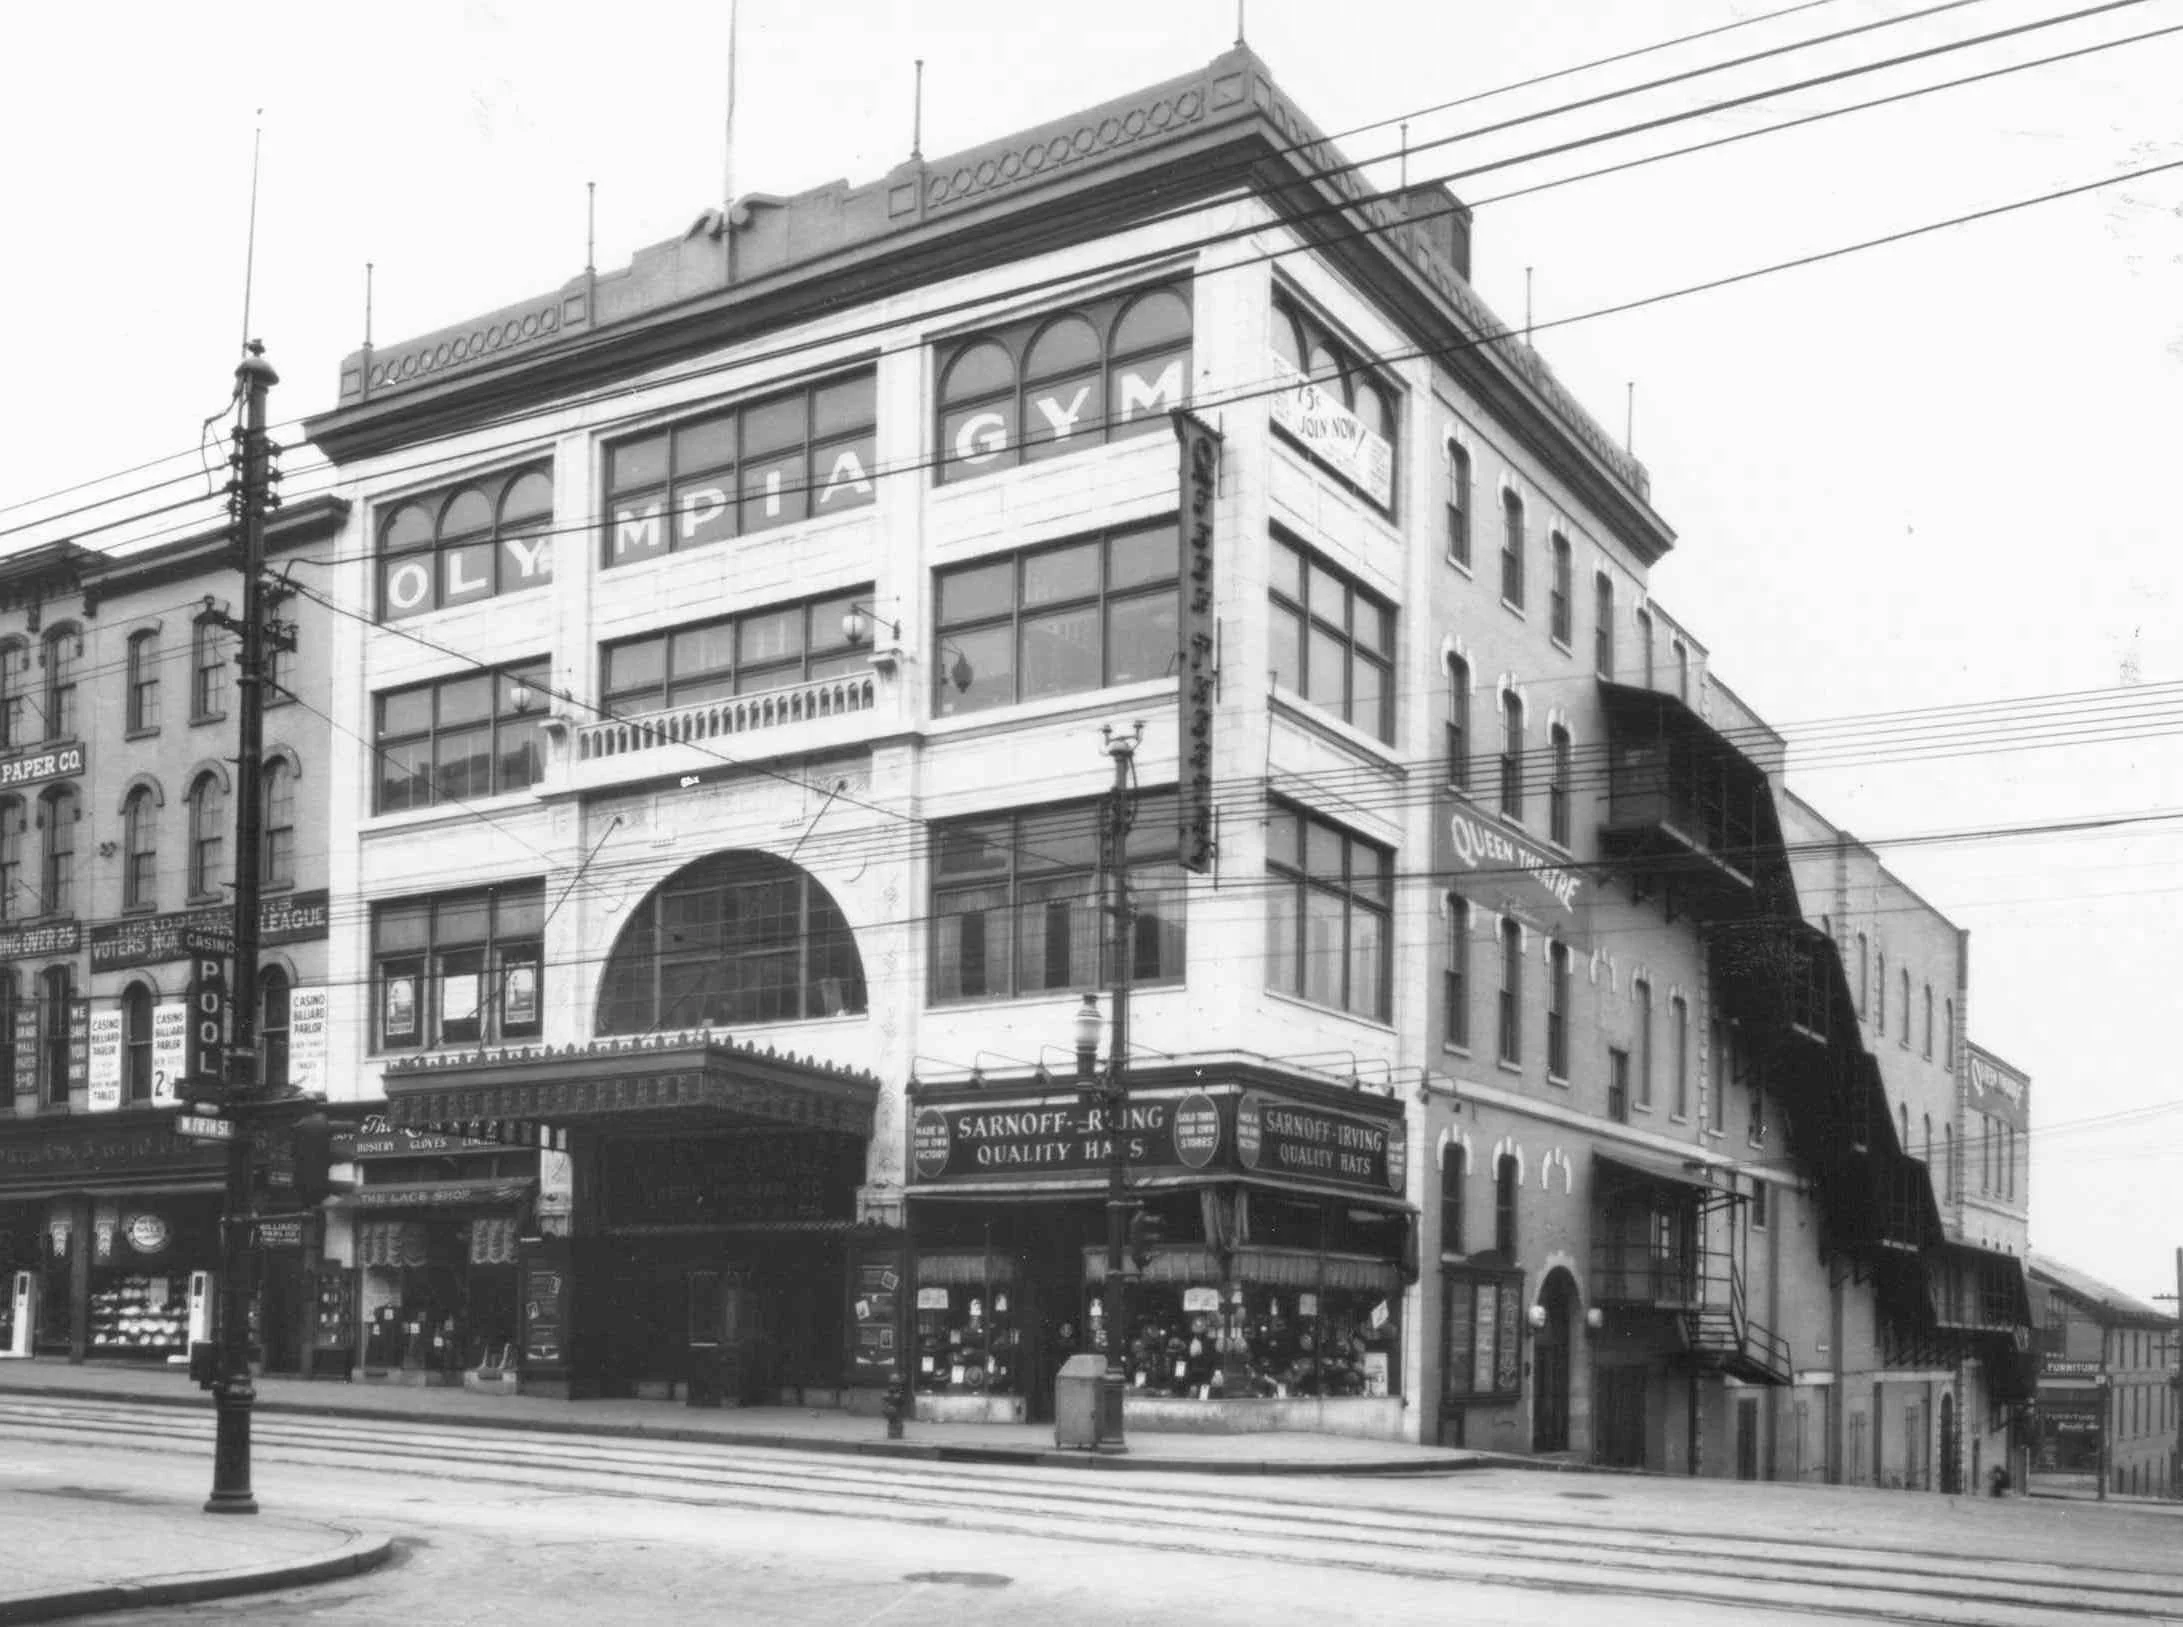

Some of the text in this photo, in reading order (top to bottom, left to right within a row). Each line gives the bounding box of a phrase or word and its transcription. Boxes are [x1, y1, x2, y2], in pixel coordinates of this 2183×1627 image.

[955, 359, 1166, 464] GYM
[2, 755, 55, 783] PAPER
[1451, 815, 1581, 914] QUEEN THEATRE
[260, 907, 326, 933] LEAGUE
[201, 960, 218, 1074] POOL
[977, 1139, 1145, 1165] QUALITY HAS
[1279, 1143, 1334, 1169] QUALITY
[1340, 1153, 1371, 1175] HATS
[2047, 1363, 2100, 1372] FURNITURE
